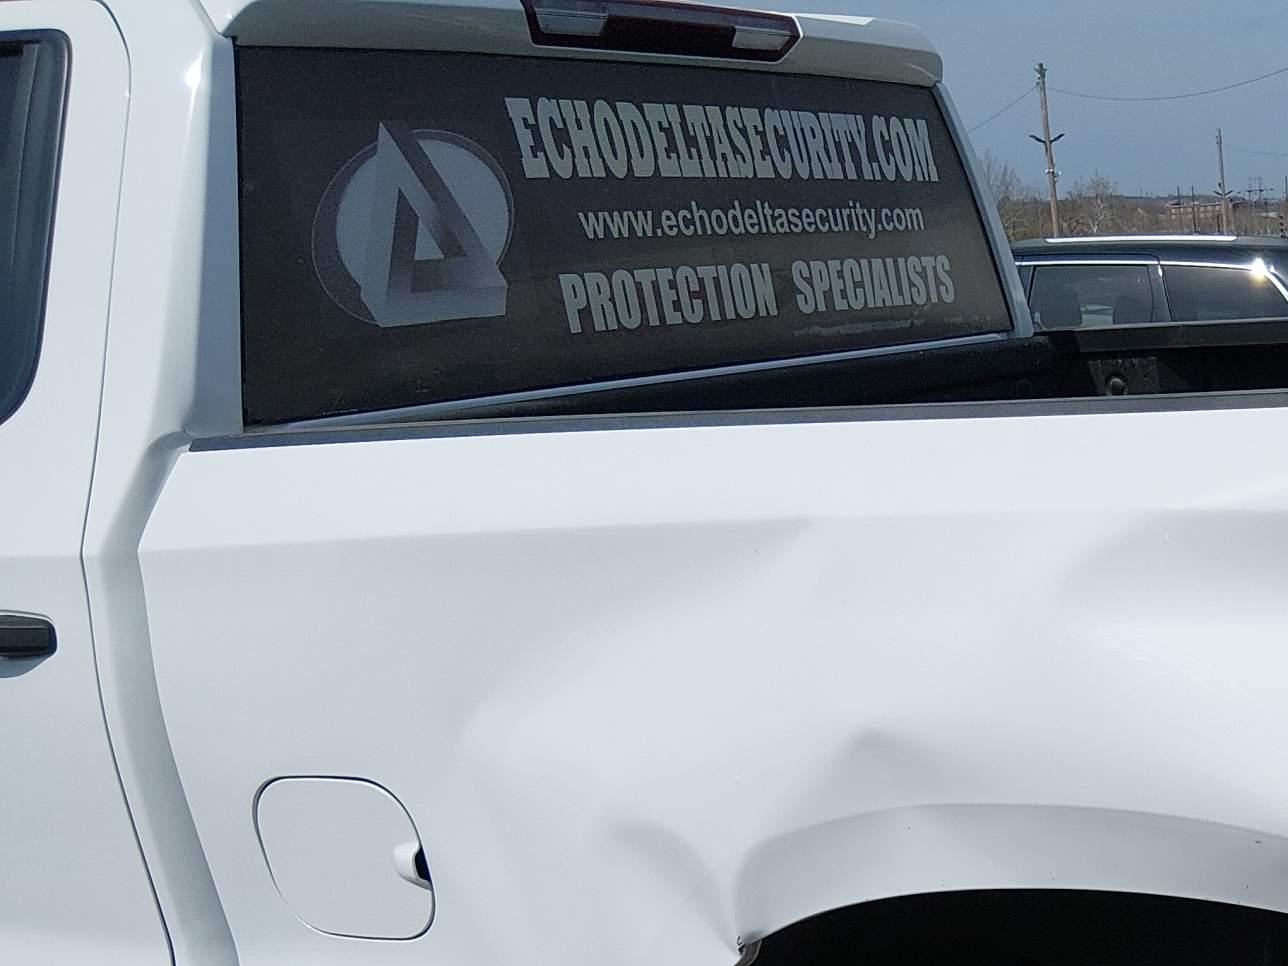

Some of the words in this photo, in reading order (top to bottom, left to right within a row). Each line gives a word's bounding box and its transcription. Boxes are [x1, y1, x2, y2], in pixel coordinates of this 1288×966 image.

[505, 97, 939, 183] ECHODELTASECURITY.COM
[578, 201, 924, 240] www.echodeltasecurity.com
[558, 262, 779, 335] PROTECTION
[792, 255, 955, 315] SPECIALISTS
